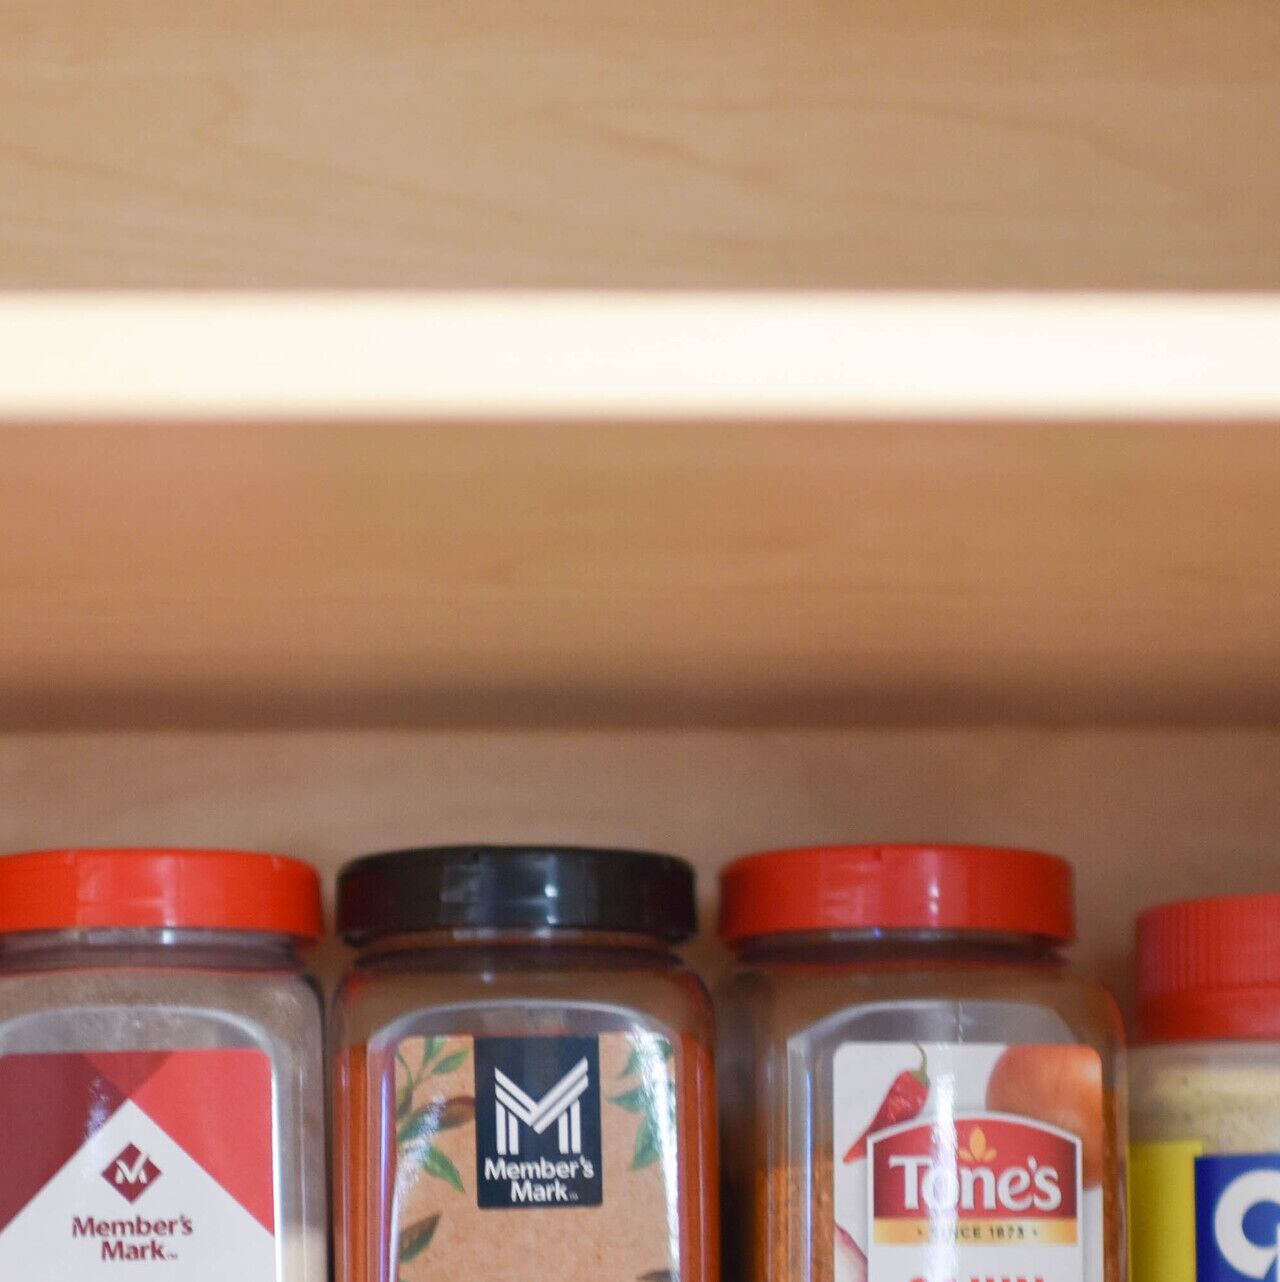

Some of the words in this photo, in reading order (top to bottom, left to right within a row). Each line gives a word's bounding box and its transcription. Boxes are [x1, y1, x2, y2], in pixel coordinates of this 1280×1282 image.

[483, 1157, 595, 1182] Member's
[888, 1155, 1062, 1213] Tone's
[72, 1214, 193, 1238] Member's
